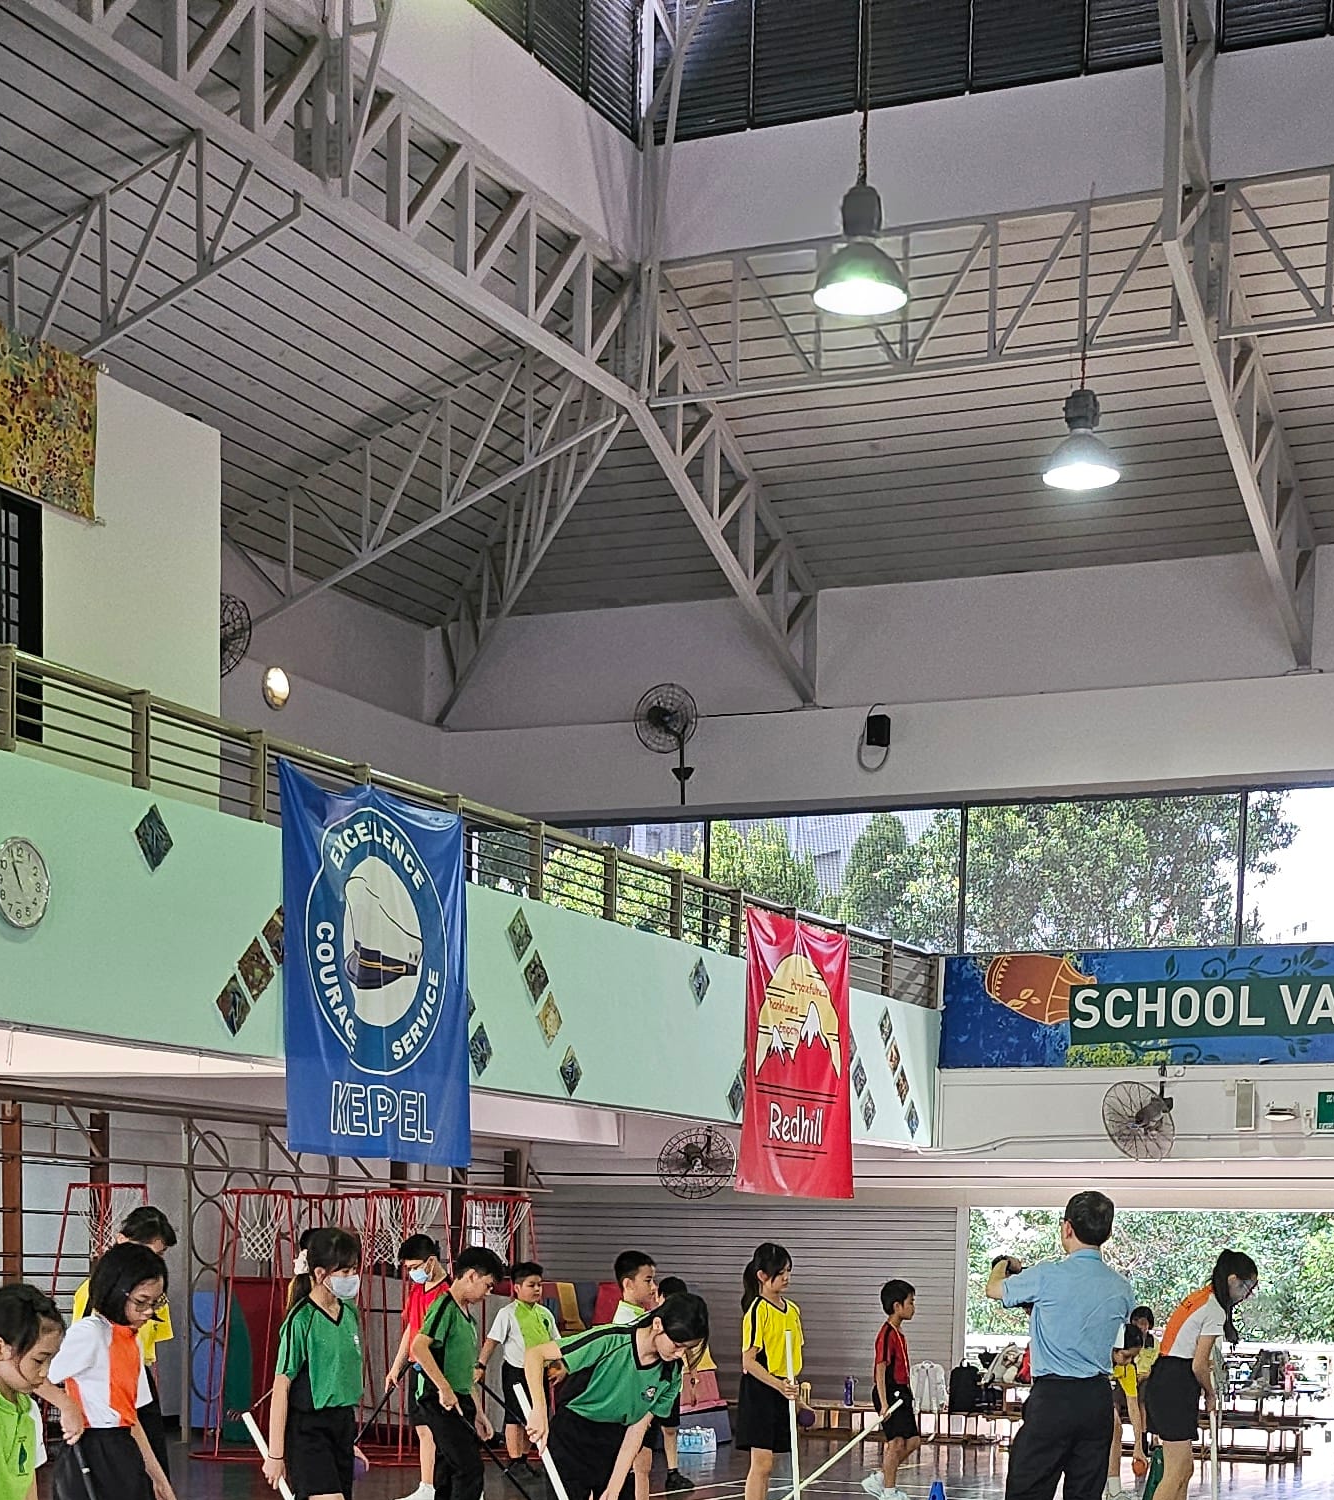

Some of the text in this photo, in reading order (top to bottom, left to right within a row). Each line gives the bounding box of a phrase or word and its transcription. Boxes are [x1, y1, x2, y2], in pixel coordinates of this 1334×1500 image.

[391, 969, 440, 1062] SERVICE
[1073, 984, 1266, 1030] SCHOOL
[768, 1102, 823, 1146] Redhill
